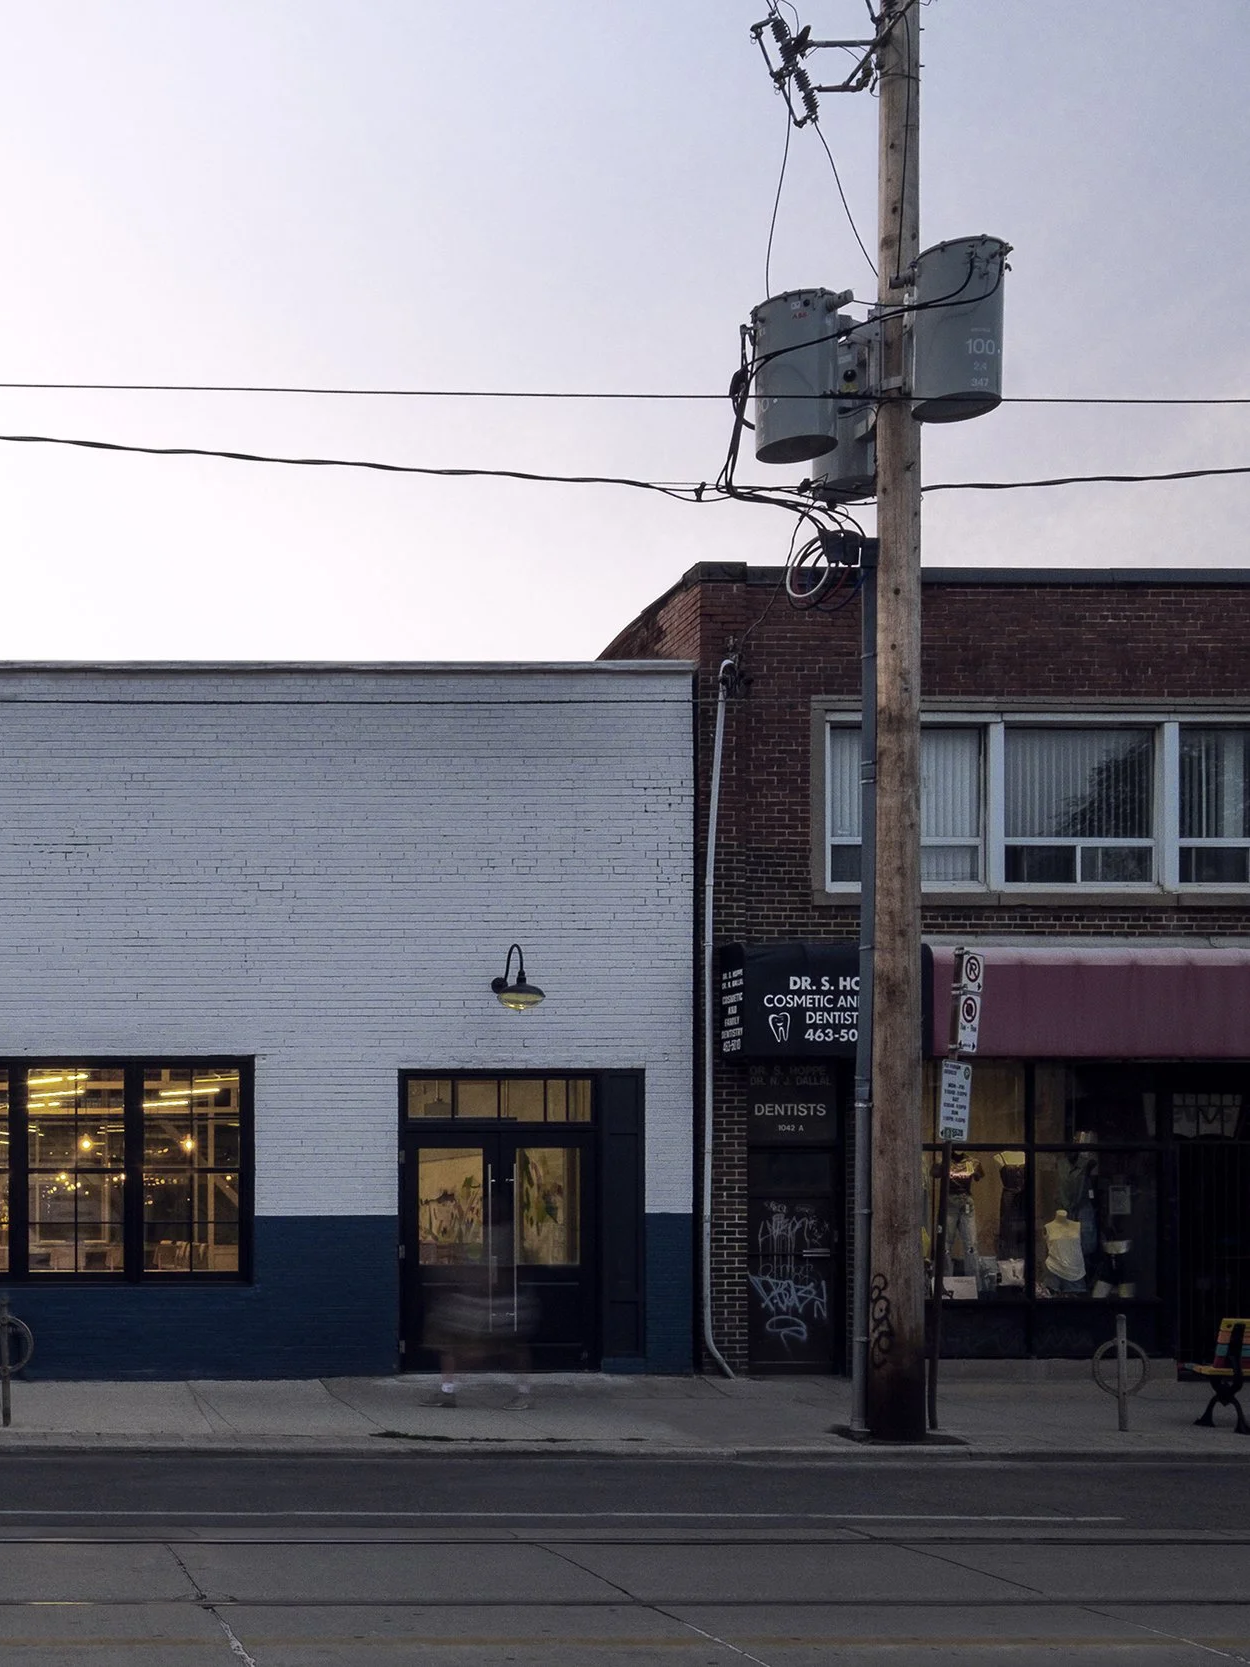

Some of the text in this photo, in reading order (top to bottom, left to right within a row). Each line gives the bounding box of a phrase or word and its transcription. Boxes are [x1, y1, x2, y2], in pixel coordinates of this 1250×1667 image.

[965, 338, 996, 355] 100
[789, 976, 816, 990] DR.
[821, 976, 834, 990] S.
[763, 994, 860, 1008] COSMETIC AN
[790, 1065, 827, 1076] HOPPE
[796, 1076, 832, 1086] DALLAL
[754, 1103, 827, 1116] DENTISTS
[778, 1124, 804, 1132] 1042 A
